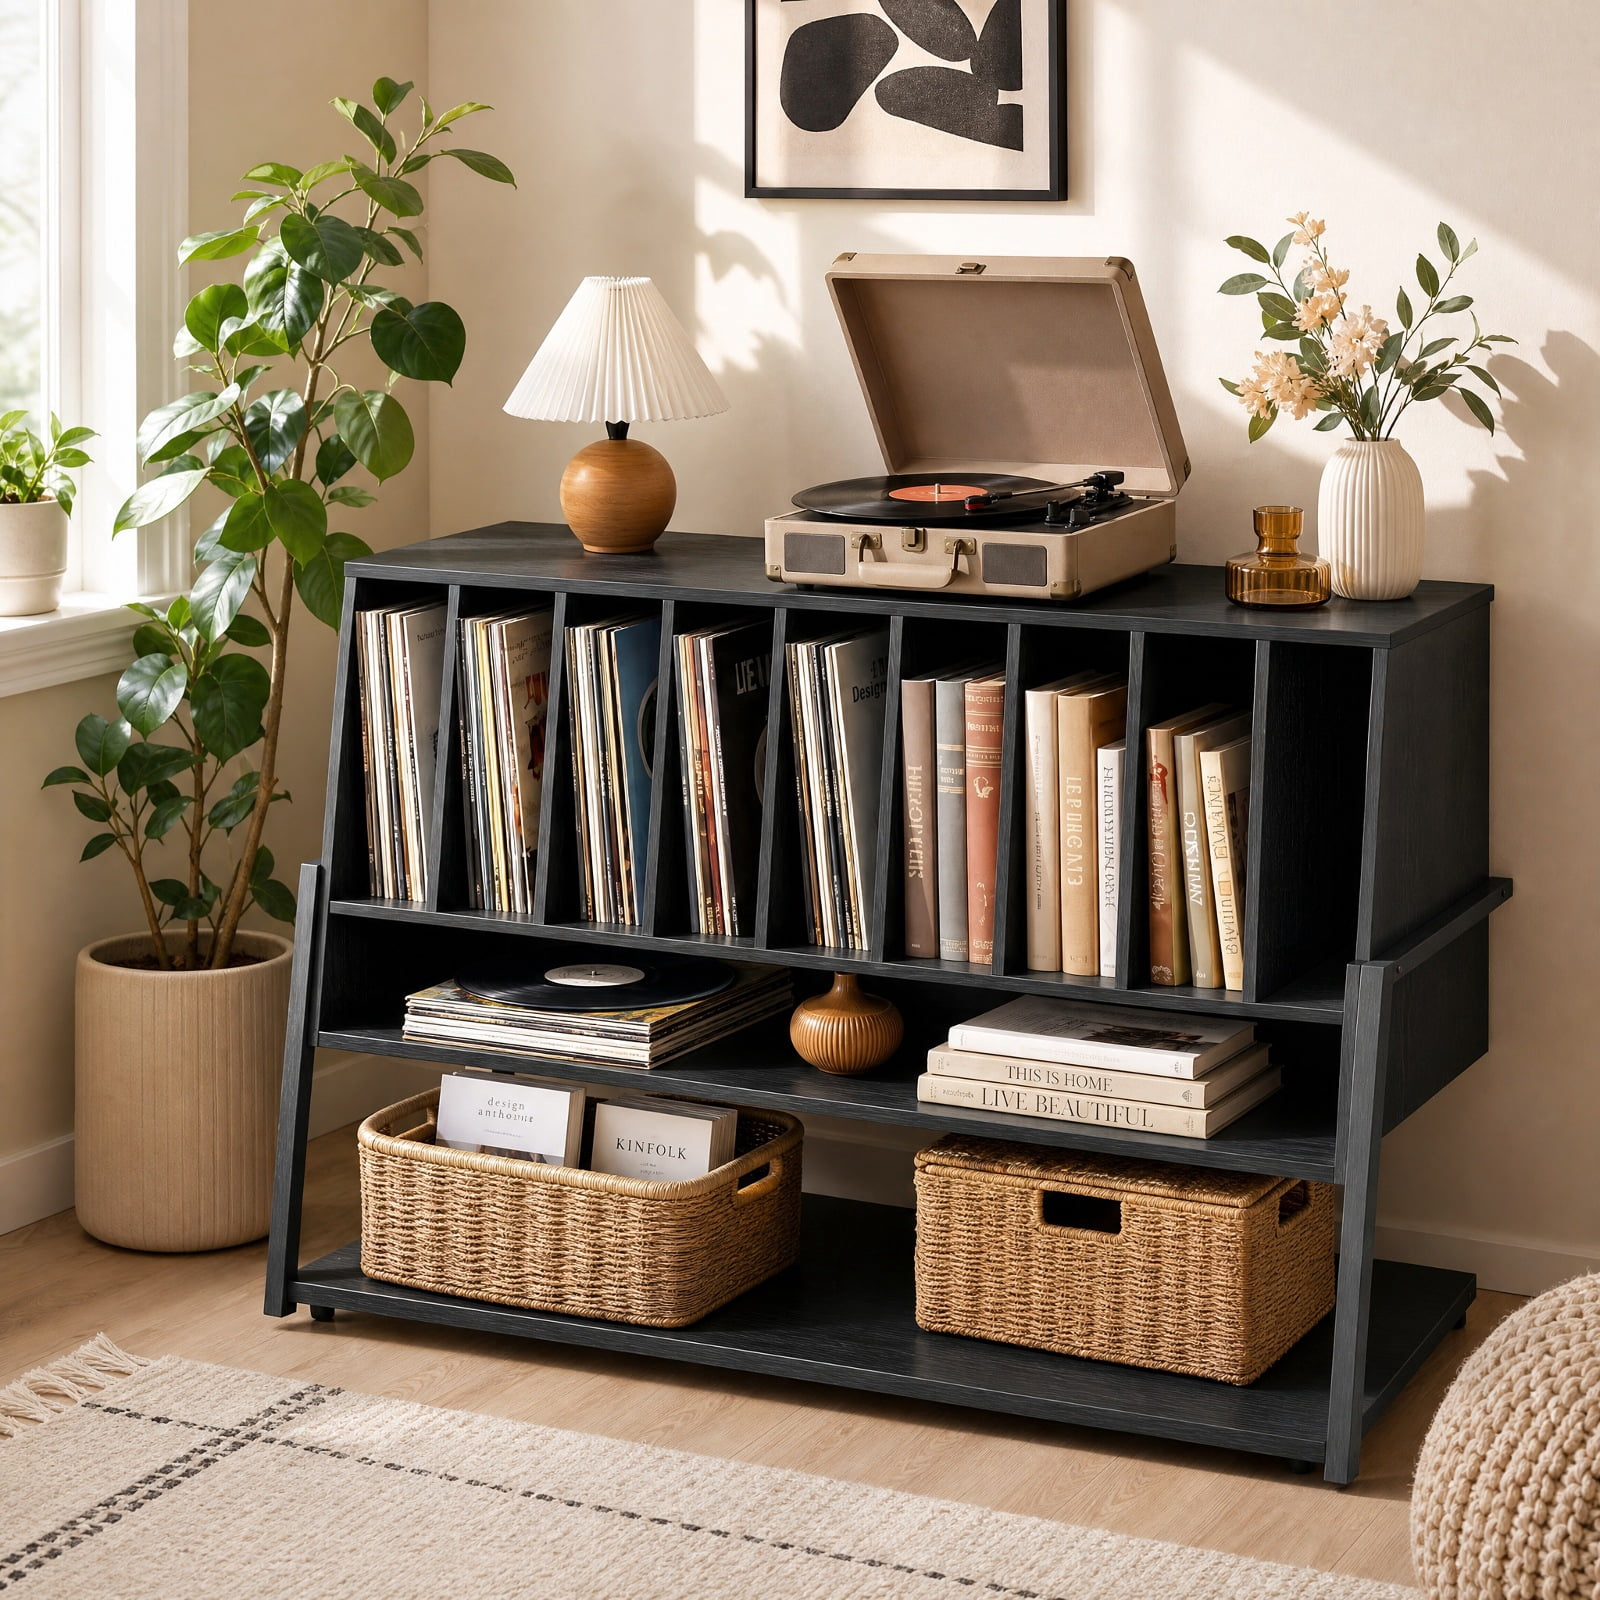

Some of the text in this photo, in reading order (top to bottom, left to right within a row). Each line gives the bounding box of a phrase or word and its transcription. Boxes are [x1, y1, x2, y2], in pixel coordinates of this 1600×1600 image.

[1005, 1065, 1113, 1093] THIS IS HOME
[487, 1096, 525, 1111] design
[981, 1087, 1028, 1112] LIVE
[1035, 1094, 1154, 1128] BEAUTIFUL
[616, 1137, 687, 1160] KINFOLK
